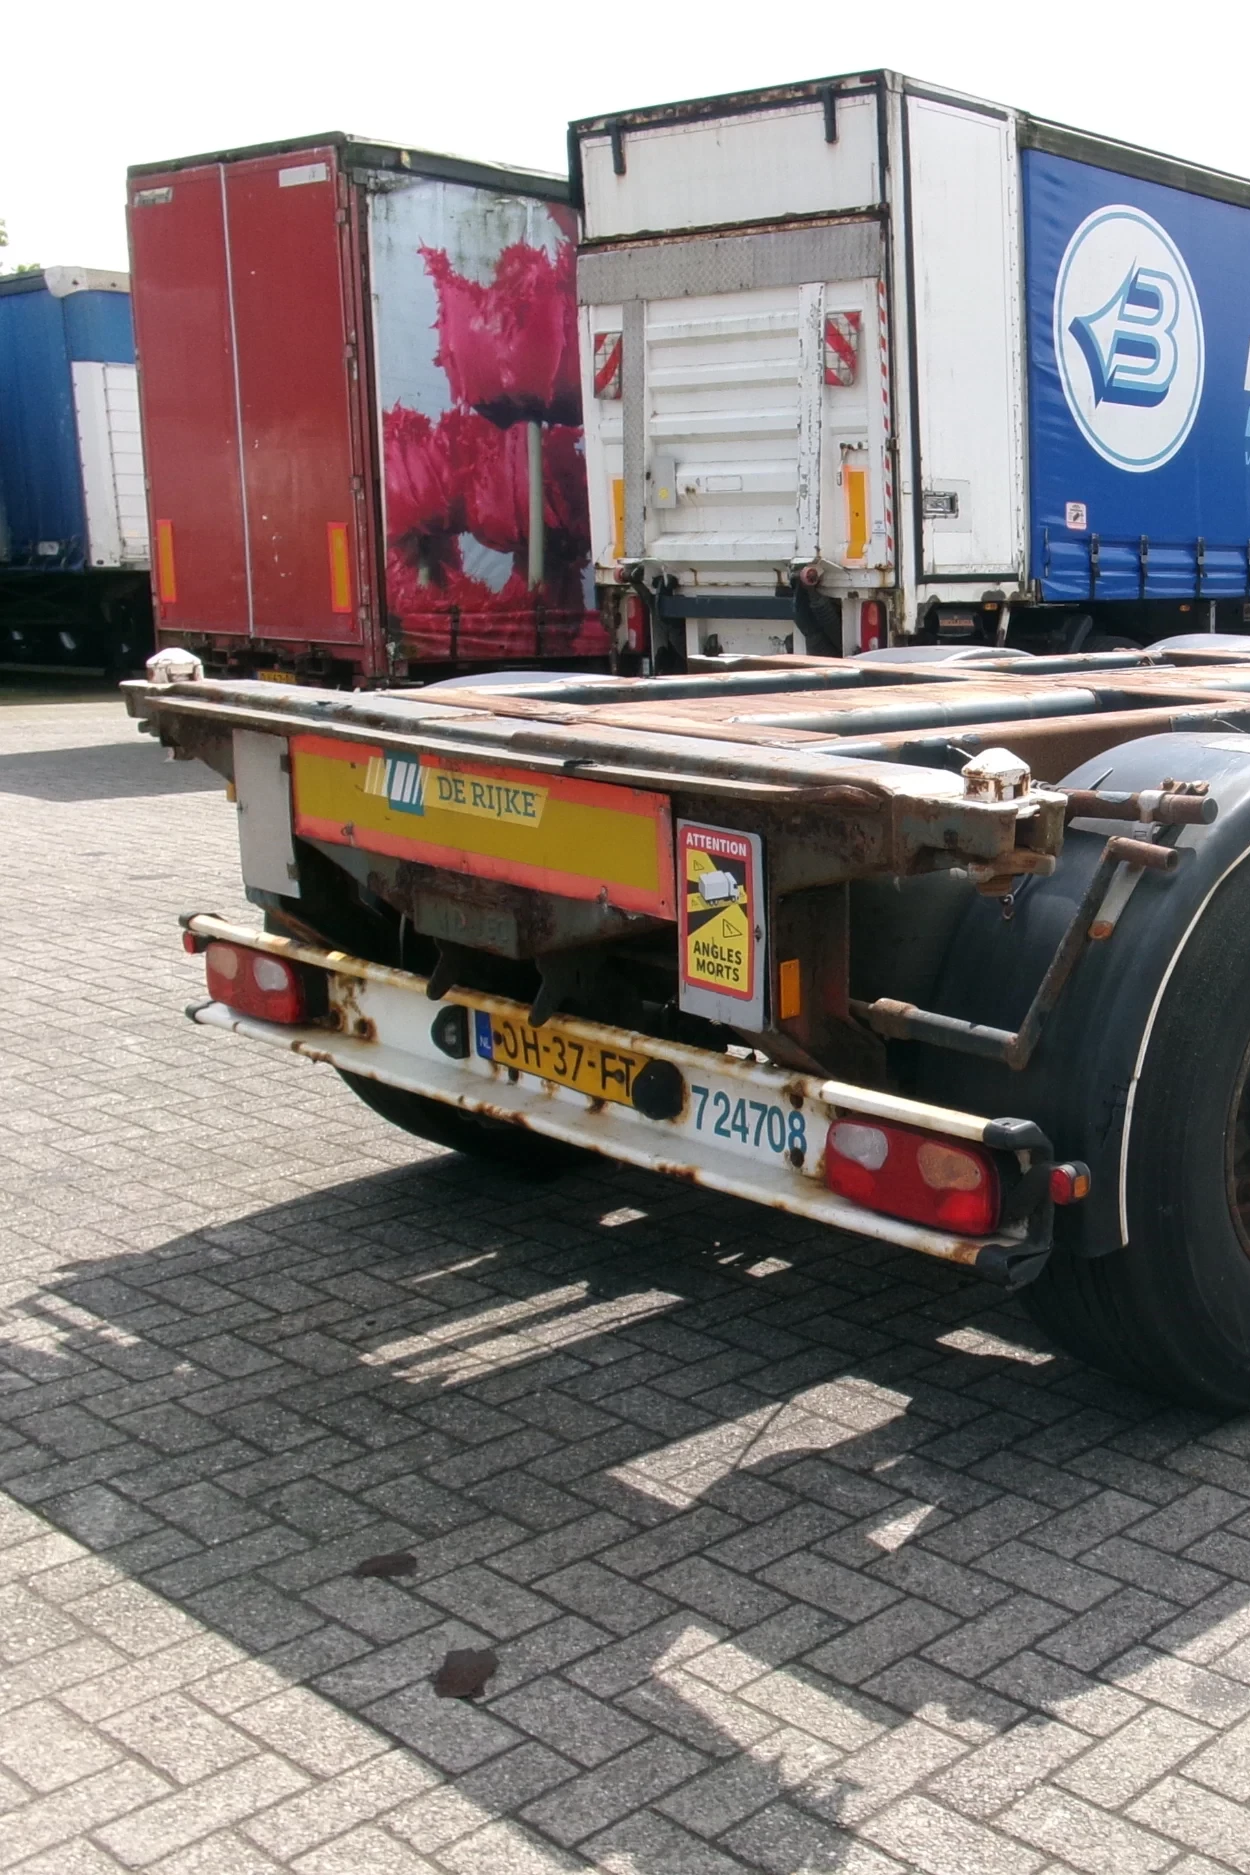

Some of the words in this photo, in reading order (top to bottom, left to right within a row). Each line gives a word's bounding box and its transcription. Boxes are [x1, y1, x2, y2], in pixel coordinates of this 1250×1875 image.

[437, 776, 466, 805] DE
[471, 782, 537, 817] RIJKE
[686, 832, 747, 857] ATTENTION
[693, 940, 742, 966] ANGLES
[696, 958, 740, 982] MORTS
[479, 1036, 492, 1050] NL
[691, 1084, 808, 1156] 724708
